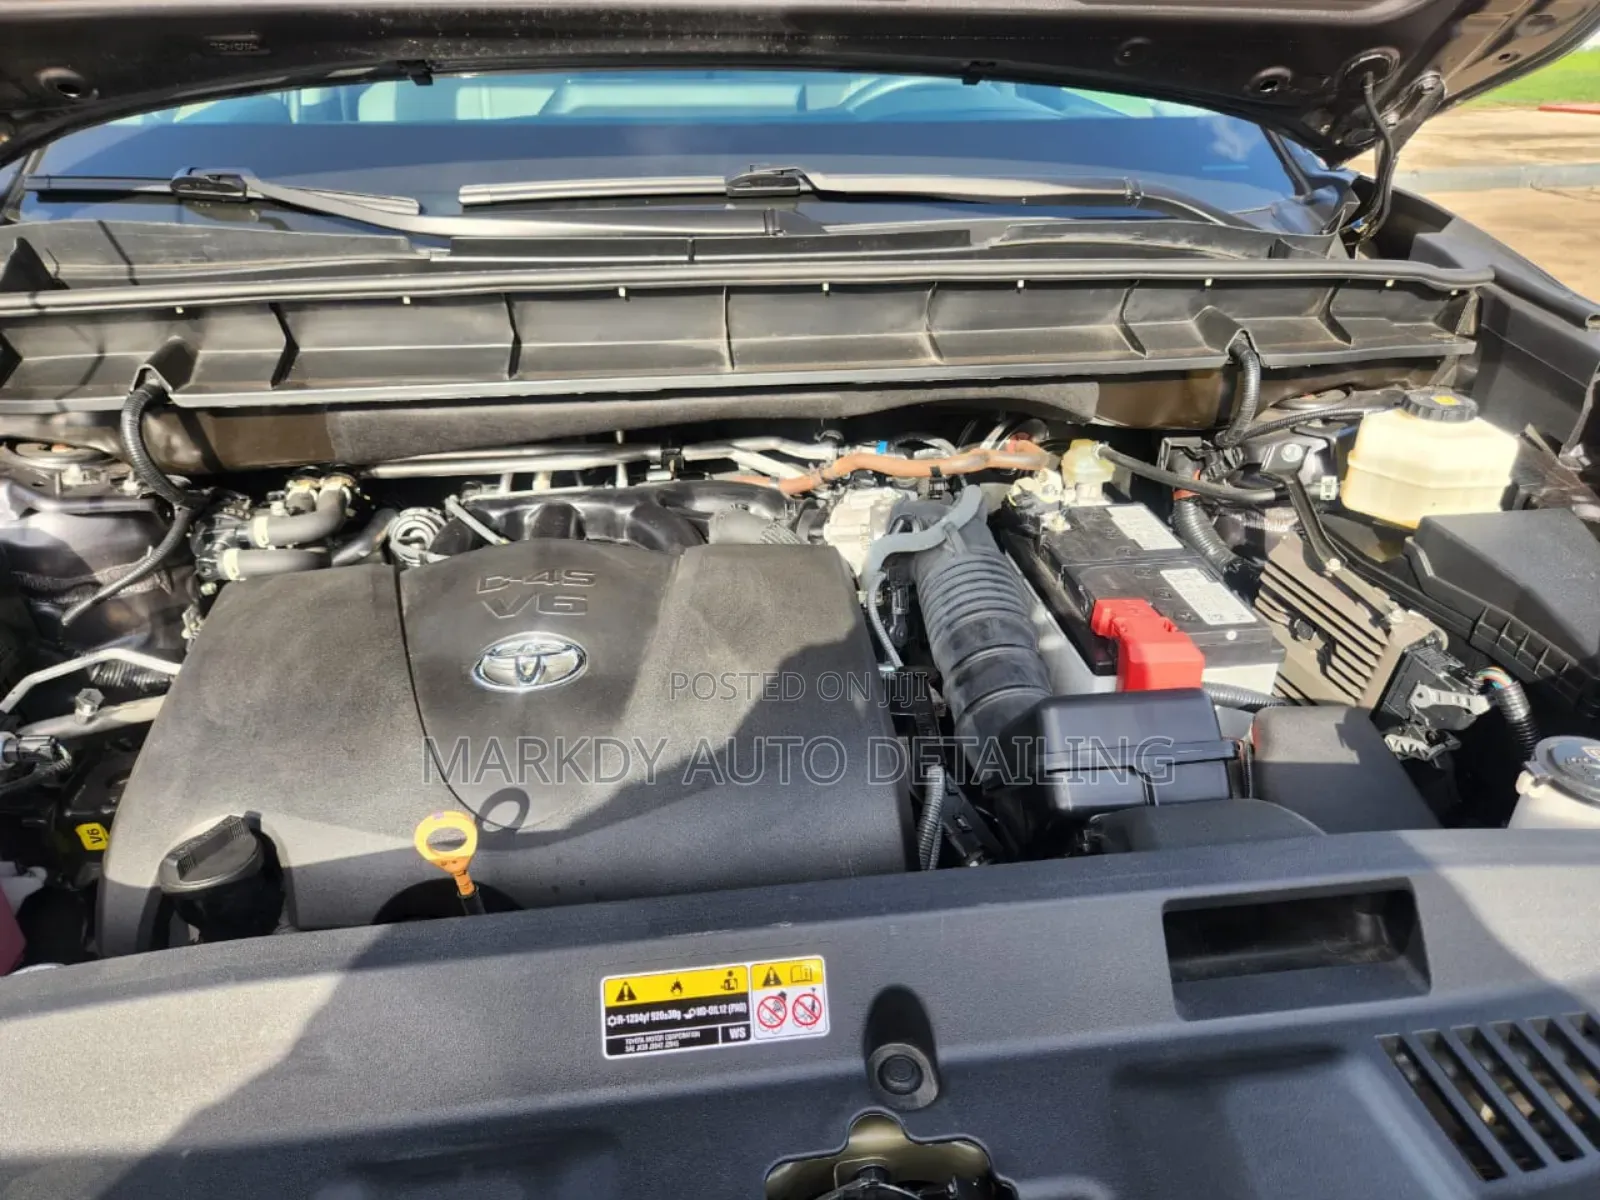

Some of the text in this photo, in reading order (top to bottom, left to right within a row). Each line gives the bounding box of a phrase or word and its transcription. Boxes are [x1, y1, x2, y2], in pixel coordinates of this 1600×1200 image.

[476, 569, 597, 594] D-4S
[481, 592, 588, 619] V6
[86, 828, 102, 844] V6
[728, 1026, 746, 1040] WS
